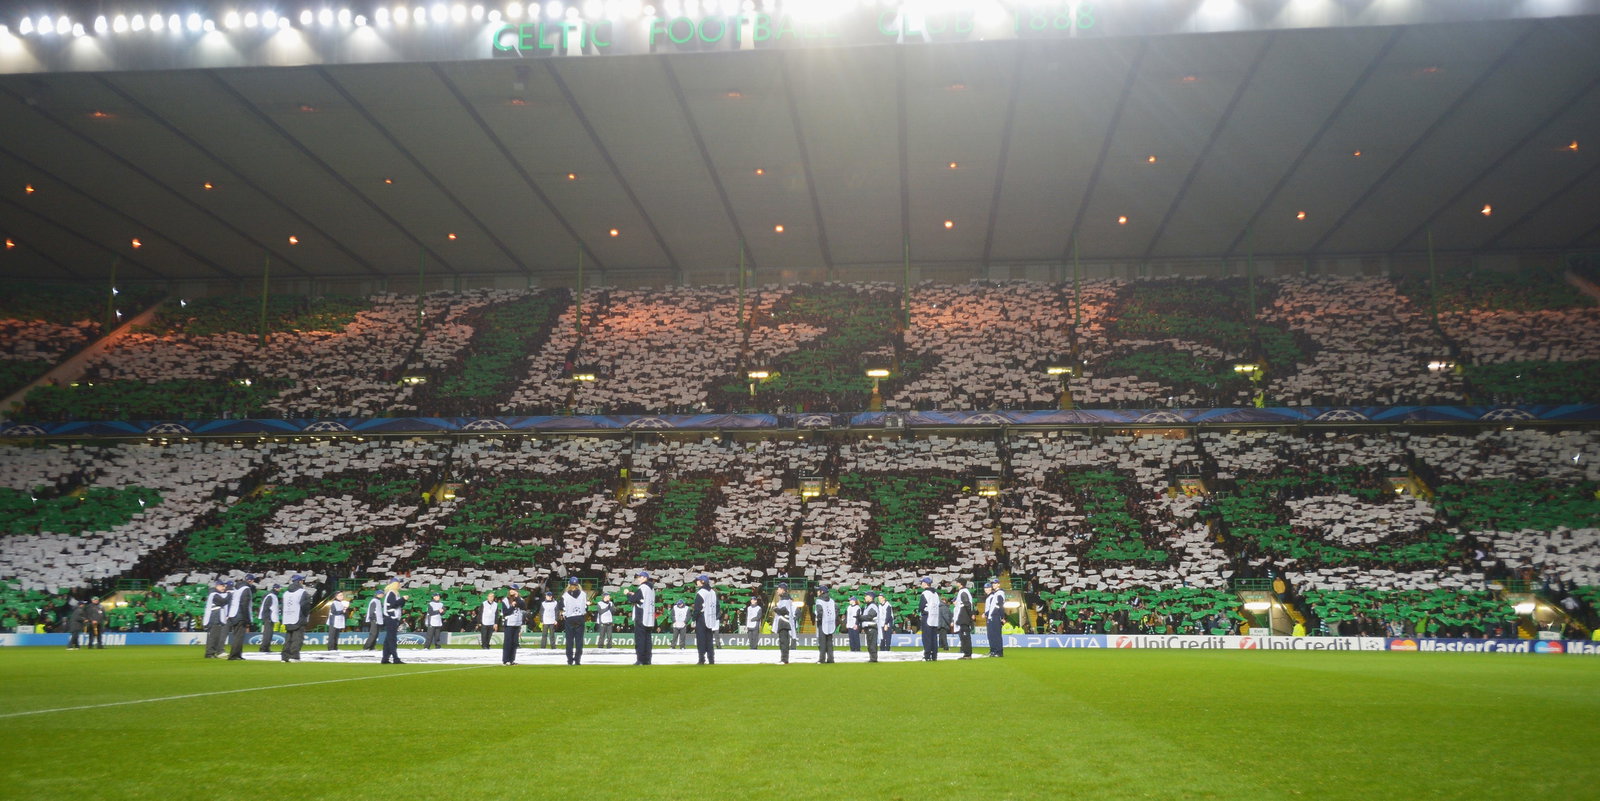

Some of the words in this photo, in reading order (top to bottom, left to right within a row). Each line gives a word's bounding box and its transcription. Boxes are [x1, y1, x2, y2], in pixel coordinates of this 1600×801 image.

[493, 22, 612, 51] CELTIC
[650, 12, 841, 45] FOOTBALL
[877, 9, 974, 37] CLUB
[1013, 1, 1096, 32] 1888
[1135, 636, 1226, 649] UniCredit
[1260, 637, 1352, 650] UniCredit
[1420, 640, 1530, 652] MasterCard
